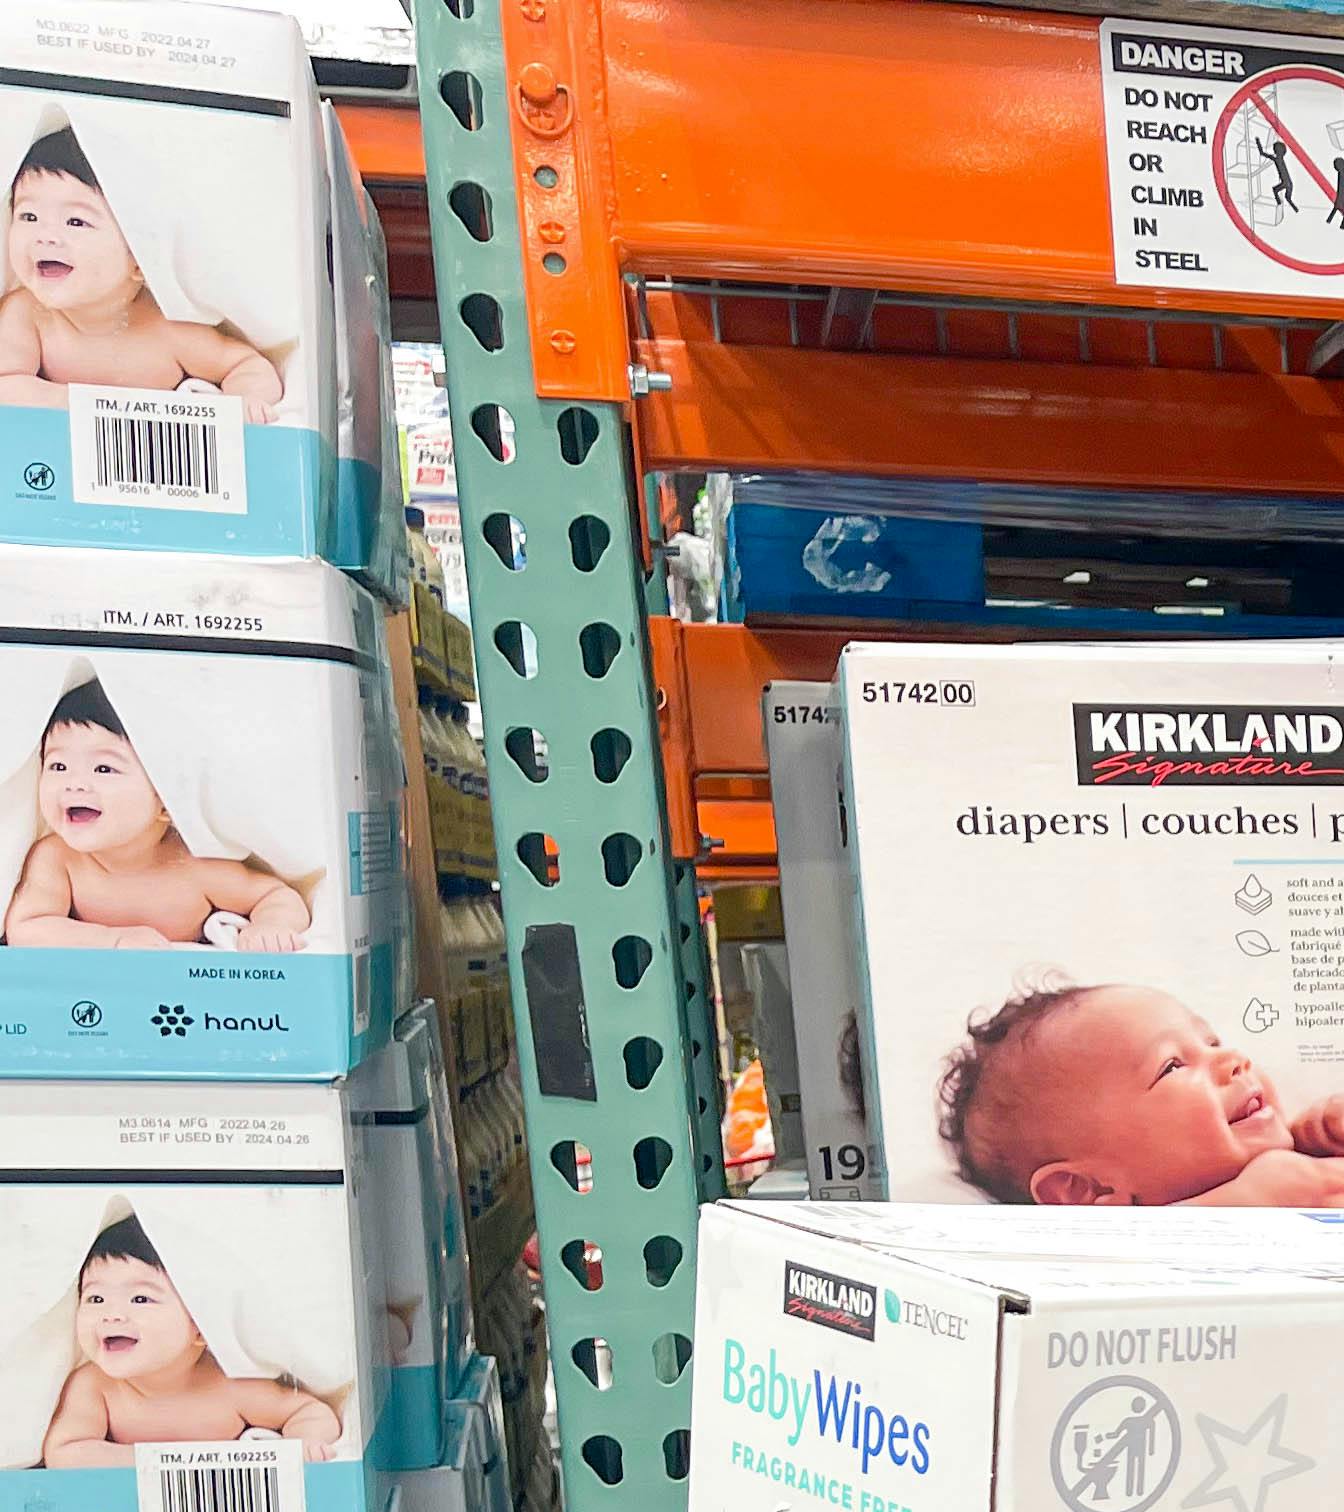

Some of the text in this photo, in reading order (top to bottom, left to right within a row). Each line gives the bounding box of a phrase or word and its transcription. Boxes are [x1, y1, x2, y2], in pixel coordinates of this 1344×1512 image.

[1120, 41, 1245, 76] DANGER
[1124, 87, 1213, 112] DO NOT
[1127, 120, 1207, 144] REACH
[1129, 152, 1163, 173] OR
[1131, 185, 1204, 208] CLIMB
[1133, 218, 1157, 237] IN
[1135, 250, 1209, 272] STEEL
[102, 610, 138, 627] ITM.
[155, 611, 189, 630] ART.
[194, 614, 263, 633] 1692255
[1089, 712, 1344, 755] KIRKLAND
[1091, 748, 1344, 787] Signature
[955, 802, 1110, 844] diapers
[1141, 803, 1300, 839] couches
[188, 967, 286, 981] MADE IN KOREA
[204, 1012, 289, 1032] hanul
[119, 1132, 154, 1145] BEST
[158, 1132, 170, 1145] IF
[174, 1132, 212, 1145] USED
[215, 1133, 234, 1146] BY
[788, 1269, 874, 1317] KIRKLAND
[1047, 1324, 1237, 1370] DO NOT FLUSH
[722, 1338, 931, 1475] BabyWipes
